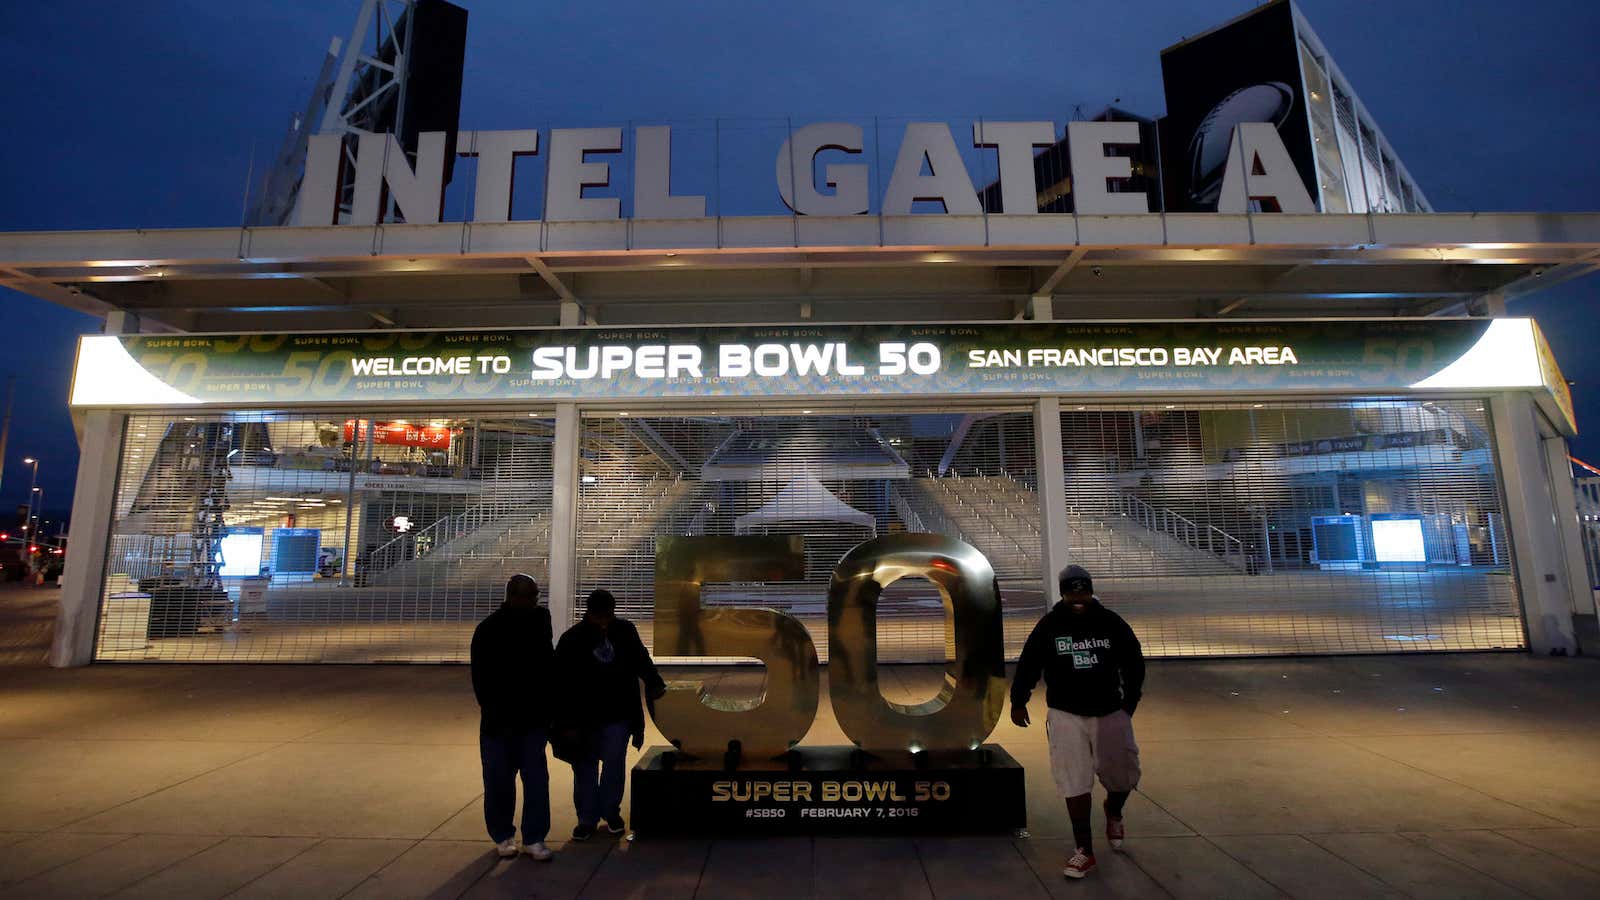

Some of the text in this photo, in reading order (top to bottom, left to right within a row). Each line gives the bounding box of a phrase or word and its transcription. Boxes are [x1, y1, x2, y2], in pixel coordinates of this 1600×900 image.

[292, 121, 1320, 225] INTEL GATE A
[147, 340, 180, 348] SUPER
[184, 339, 212, 347] BOWL
[331, 337, 360, 345] BOWL
[531, 342, 941, 380] SUPER BOWL 50
[968, 346, 1298, 367] SAN FRANCISCO BAY AREA
[351, 355, 511, 376] WELCOME TO
[983, 373, 1017, 381] SUPER
[1138, 371, 1172, 379] SUPER
[207, 383, 272, 392] SUPER BOWL
[356, 381, 390, 389] SUPER
[647, 533, 1006, 758] 50
[1057, 638, 1111, 652] Breaking
[1074, 654, 1099, 666] Bad
[712, 781, 950, 801] SUPER BOWL 50
[745, 807, 919, 819] #SB50 FEBRUARY 7, 2016
